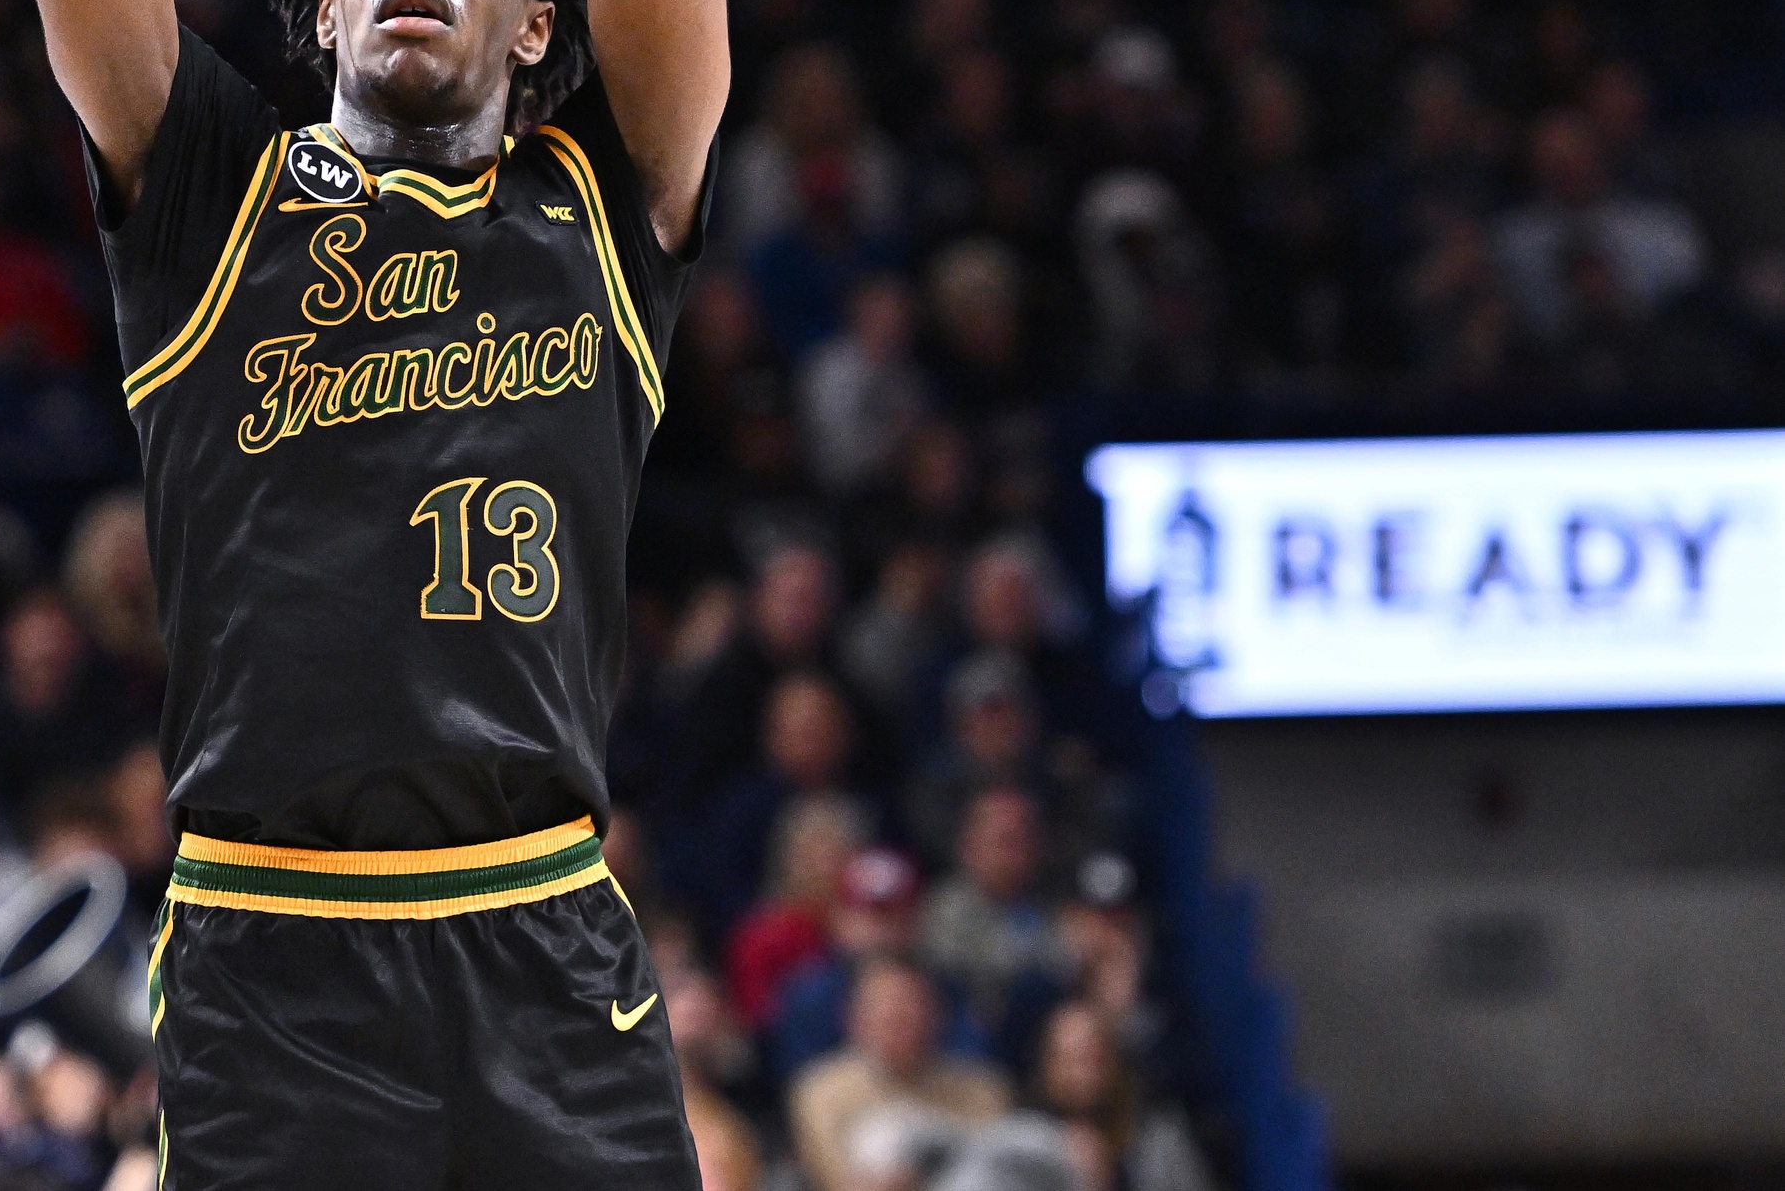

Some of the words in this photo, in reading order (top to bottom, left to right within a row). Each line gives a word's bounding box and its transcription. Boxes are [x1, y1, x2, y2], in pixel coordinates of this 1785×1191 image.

[296, 150, 353, 189] LW
[539, 204, 575, 222] WCC
[301, 213, 460, 326] San
[237, 312, 604, 455] Francisco
[409, 477, 561, 623] 13
[1268, 502, 1726, 616] READY
